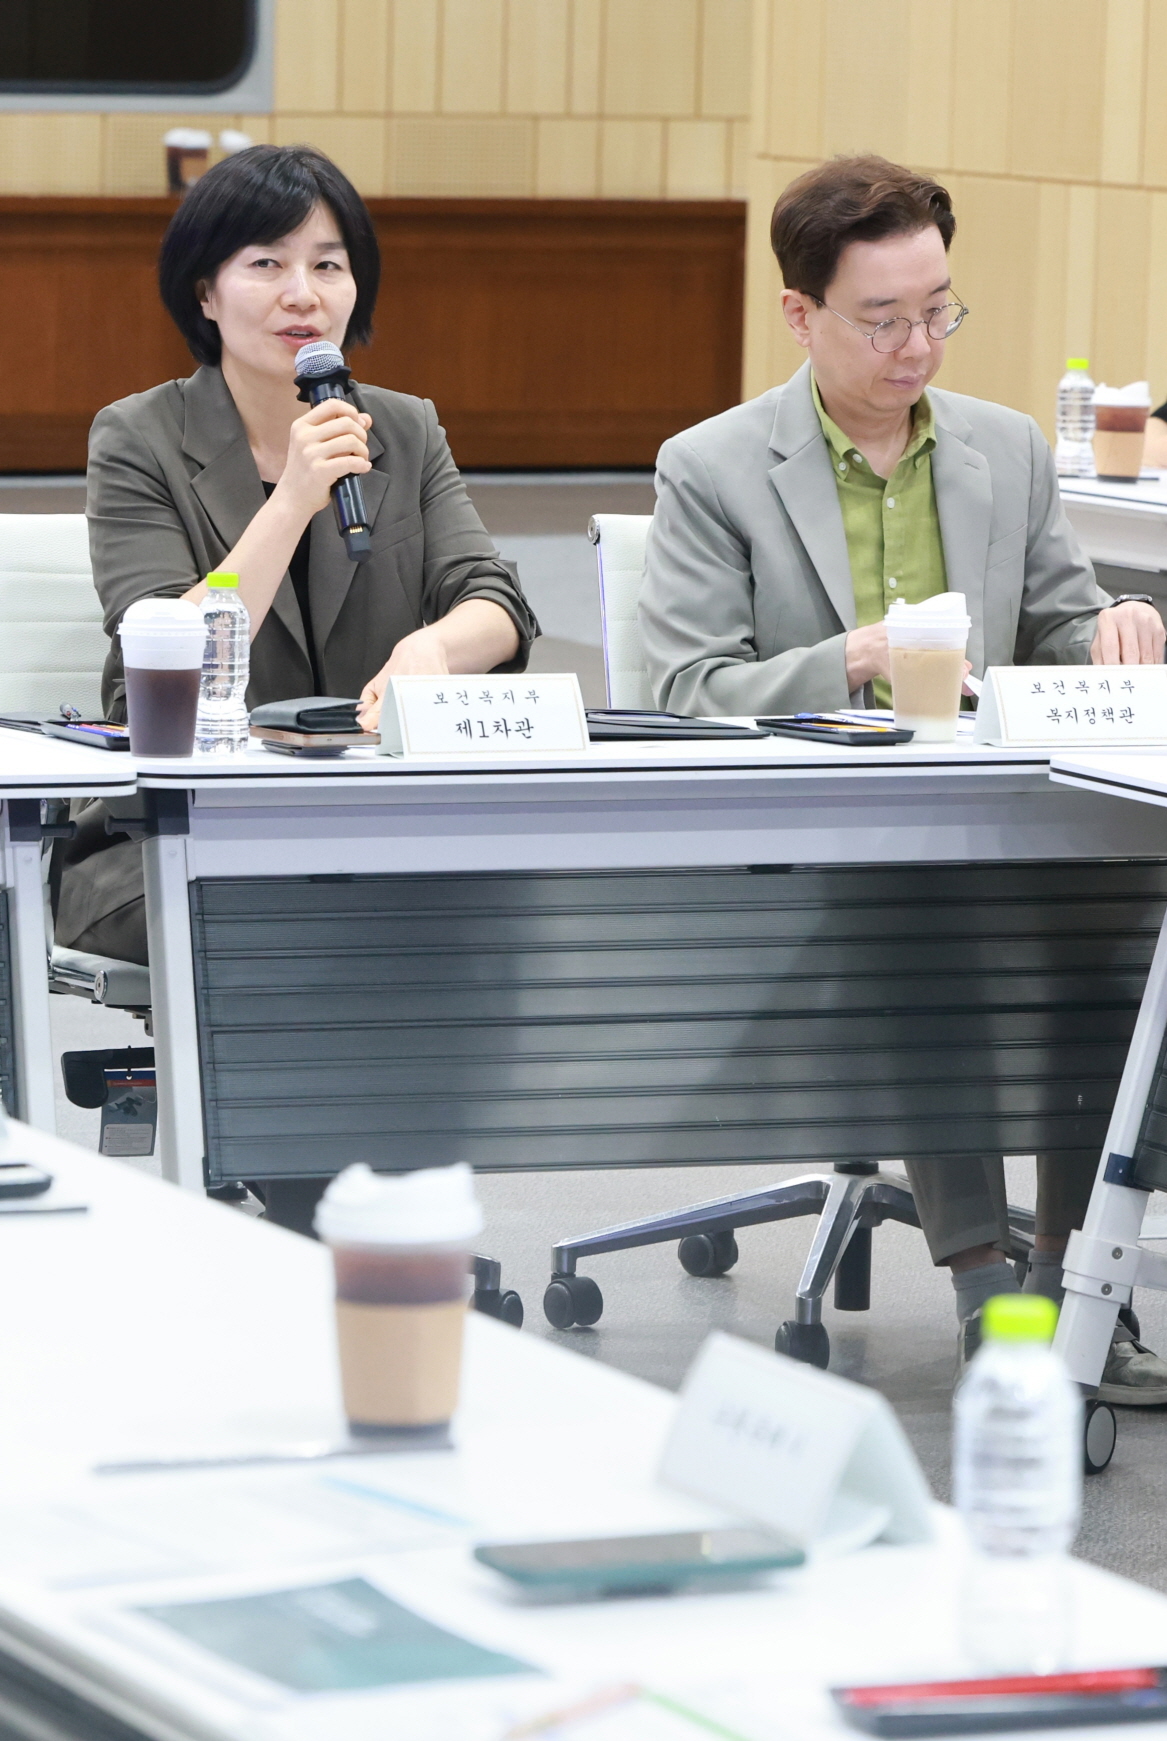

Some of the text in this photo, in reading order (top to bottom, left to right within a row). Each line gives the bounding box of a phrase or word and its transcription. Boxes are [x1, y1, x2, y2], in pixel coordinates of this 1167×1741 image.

[1030, 679, 1136, 696] 보건복지부
[433, 689, 541, 706] 보건복지부
[1046, 706, 1136, 725] 복지정책관
[455, 717, 535, 740] 제1차관
